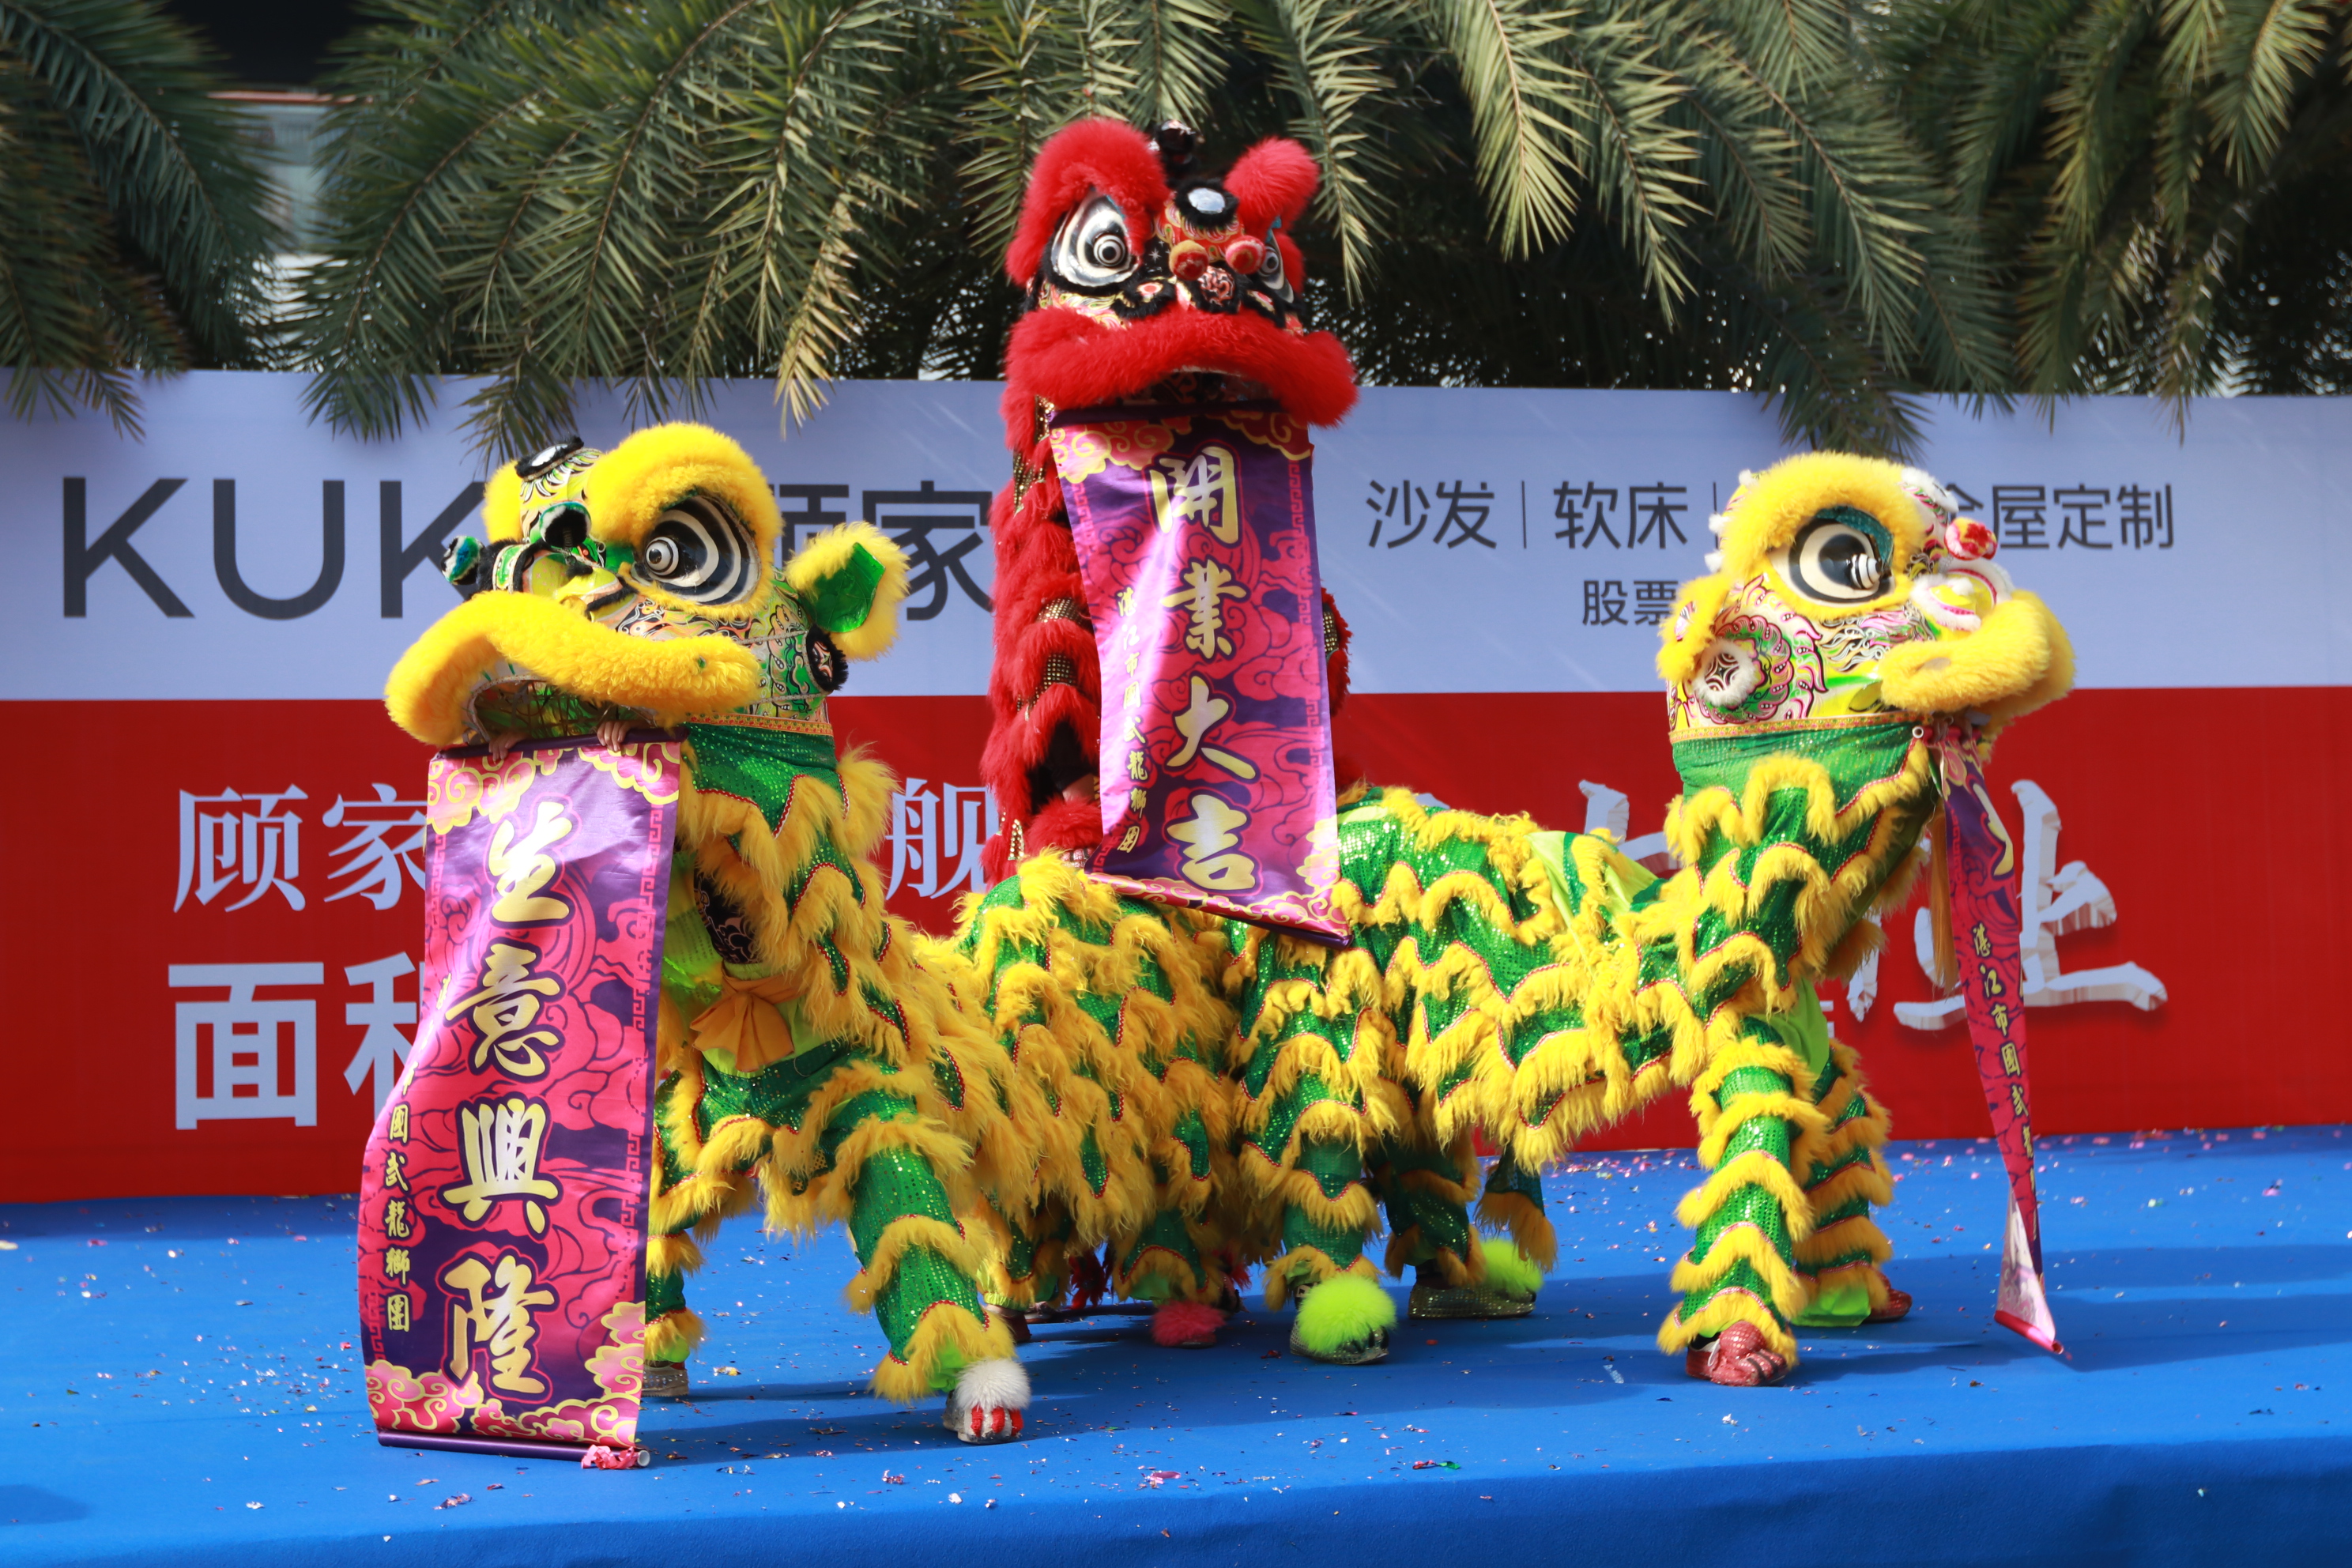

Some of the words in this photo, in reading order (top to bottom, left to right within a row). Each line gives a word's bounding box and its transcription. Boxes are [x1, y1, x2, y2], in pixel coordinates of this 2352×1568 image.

[1366, 480, 1497, 549] 沙发
[1554, 481, 1689, 549] 软床
[1947, 483, 2175, 549] 屋定制
[174, 783, 427, 913] 顾家
